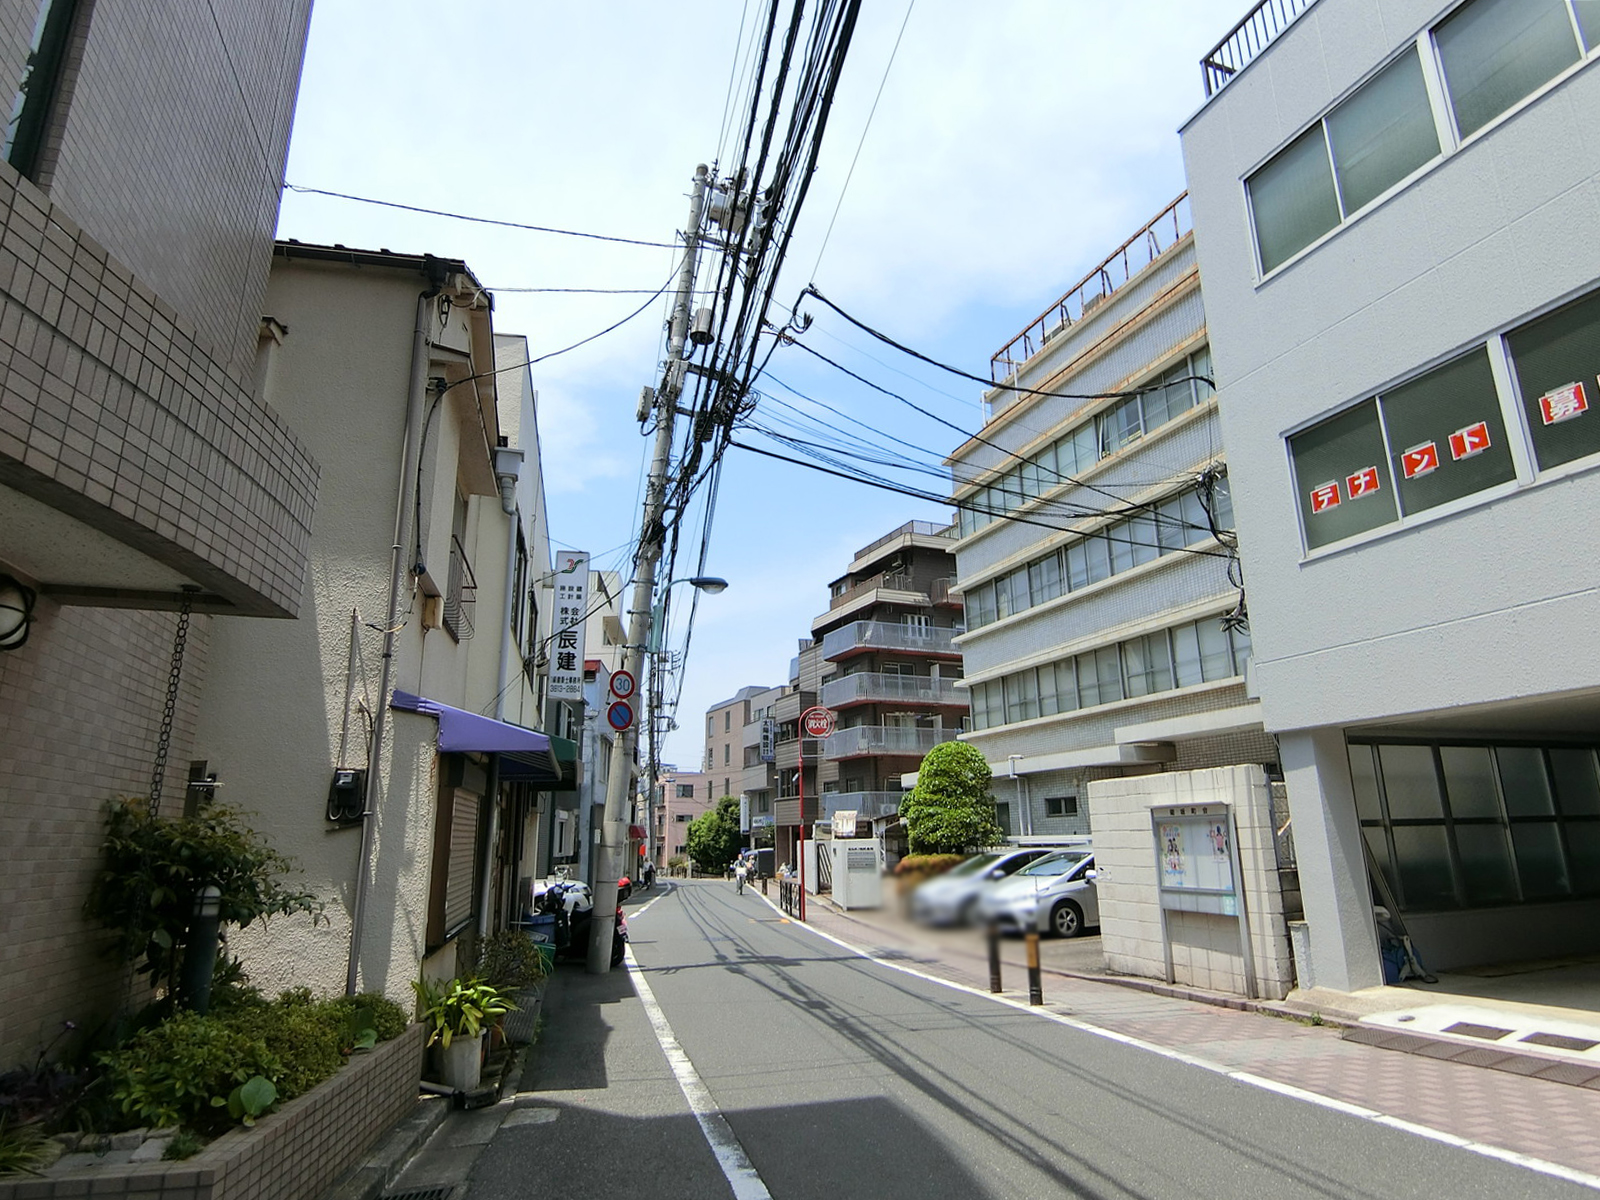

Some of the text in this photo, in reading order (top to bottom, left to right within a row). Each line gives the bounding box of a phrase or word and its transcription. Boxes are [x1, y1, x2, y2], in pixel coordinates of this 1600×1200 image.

[1316, 430, 1482, 510] テナント
[556, 630, 578, 671] 辰建
[615, 677, 630, 692] 30
[807, 718, 828, 730] 消火栓
